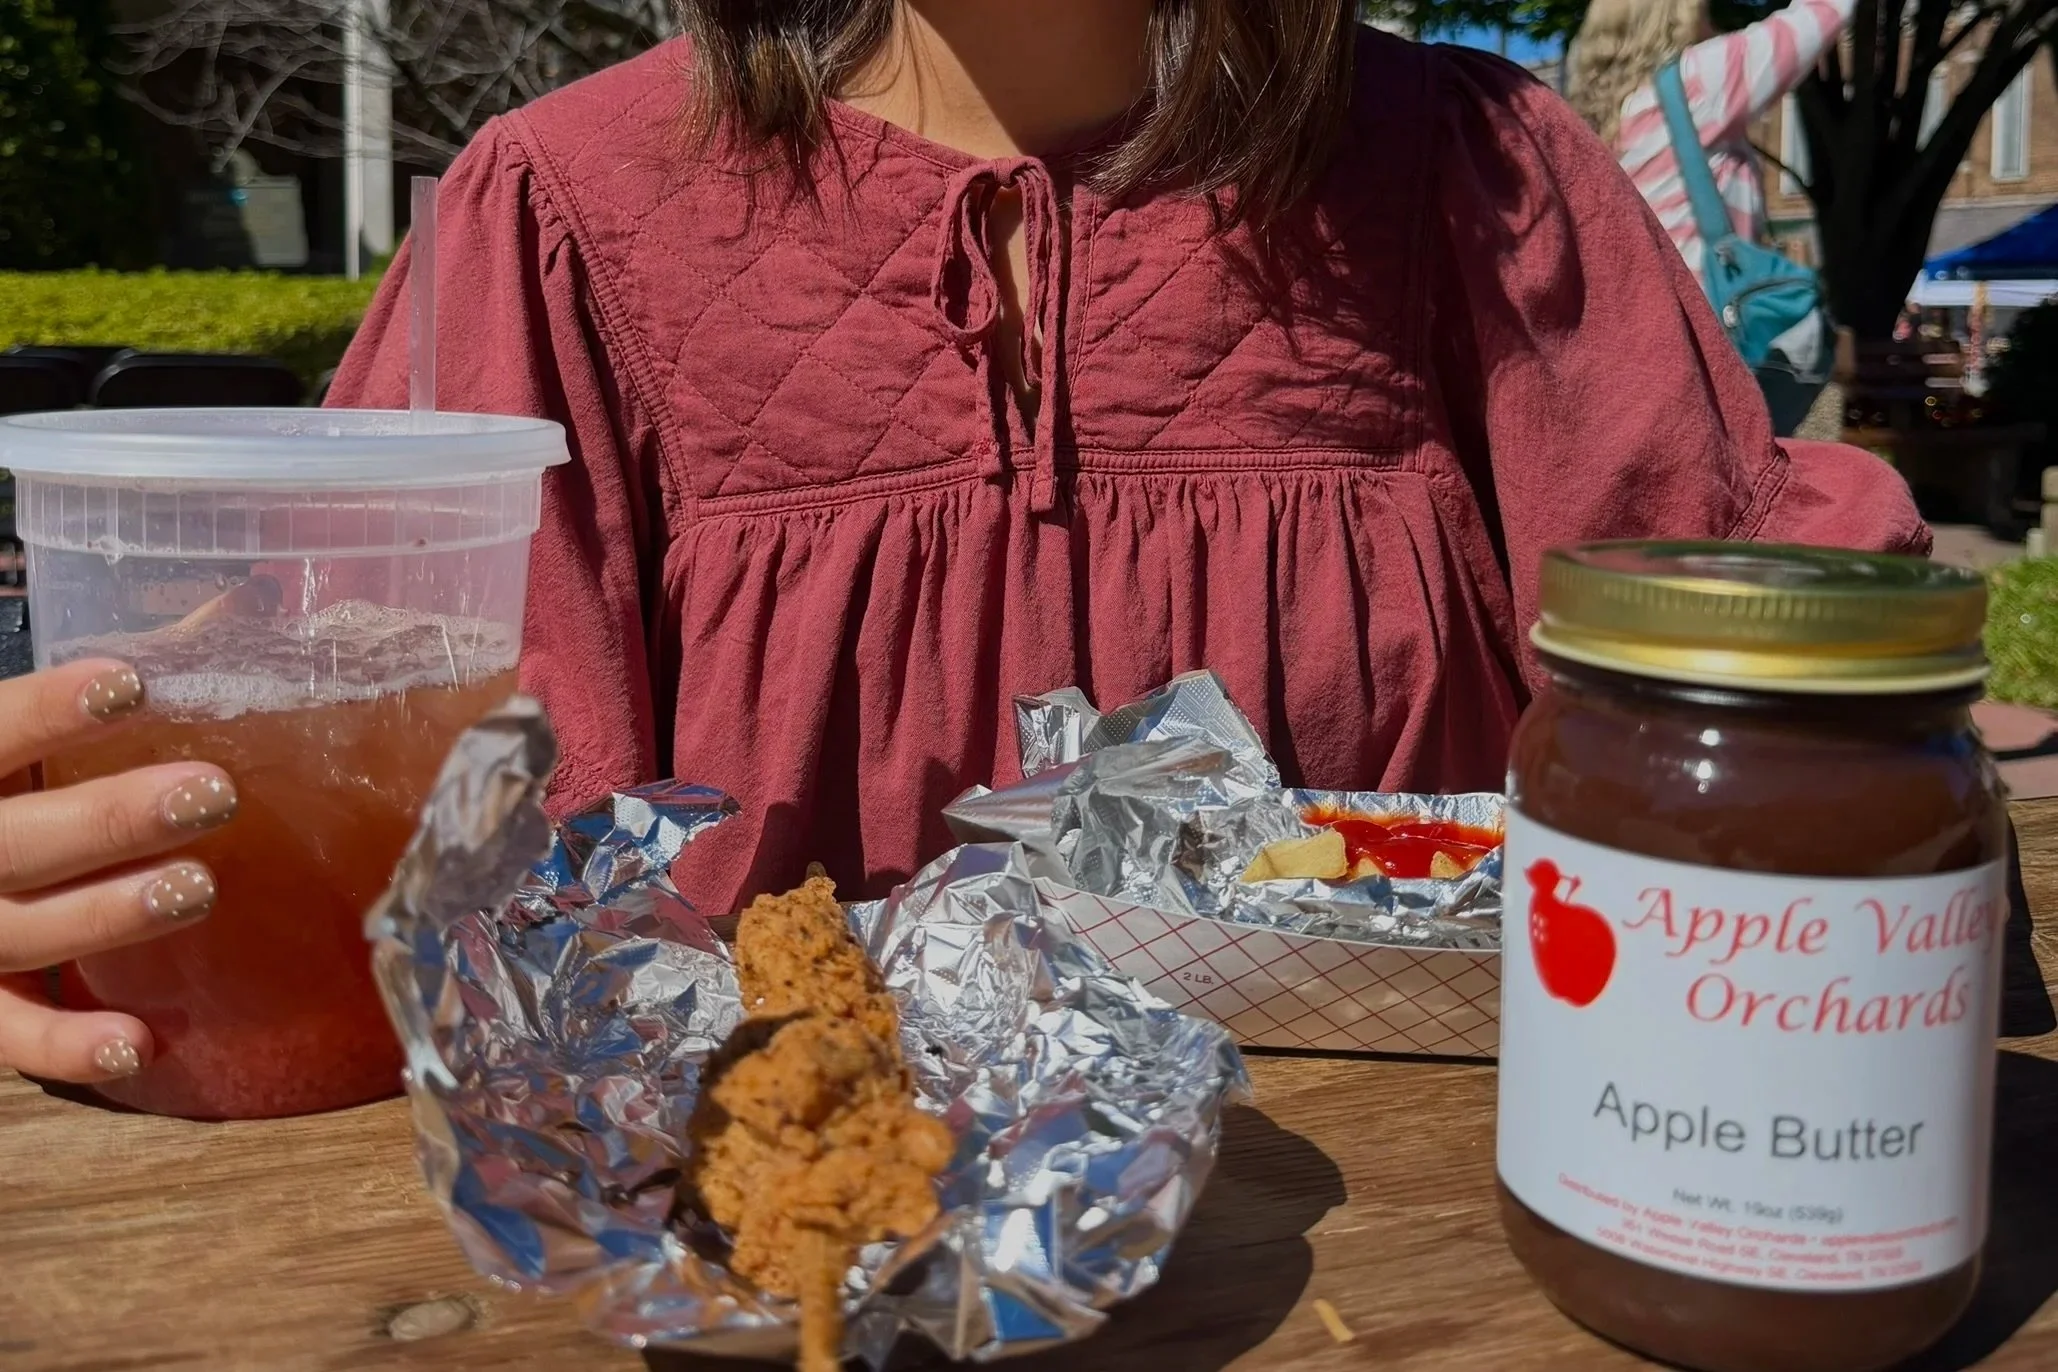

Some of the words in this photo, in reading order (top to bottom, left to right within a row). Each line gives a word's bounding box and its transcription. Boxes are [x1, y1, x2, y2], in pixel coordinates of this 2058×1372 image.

[1622, 886, 1828, 966] Apple
[1183, 972, 1192, 981] 2
[1195, 973, 1214, 985] LB.
[1686, 965, 1971, 1035] Orchards
[1593, 1081, 1746, 1153] Apple
[1770, 1114, 1925, 1162] Butter
